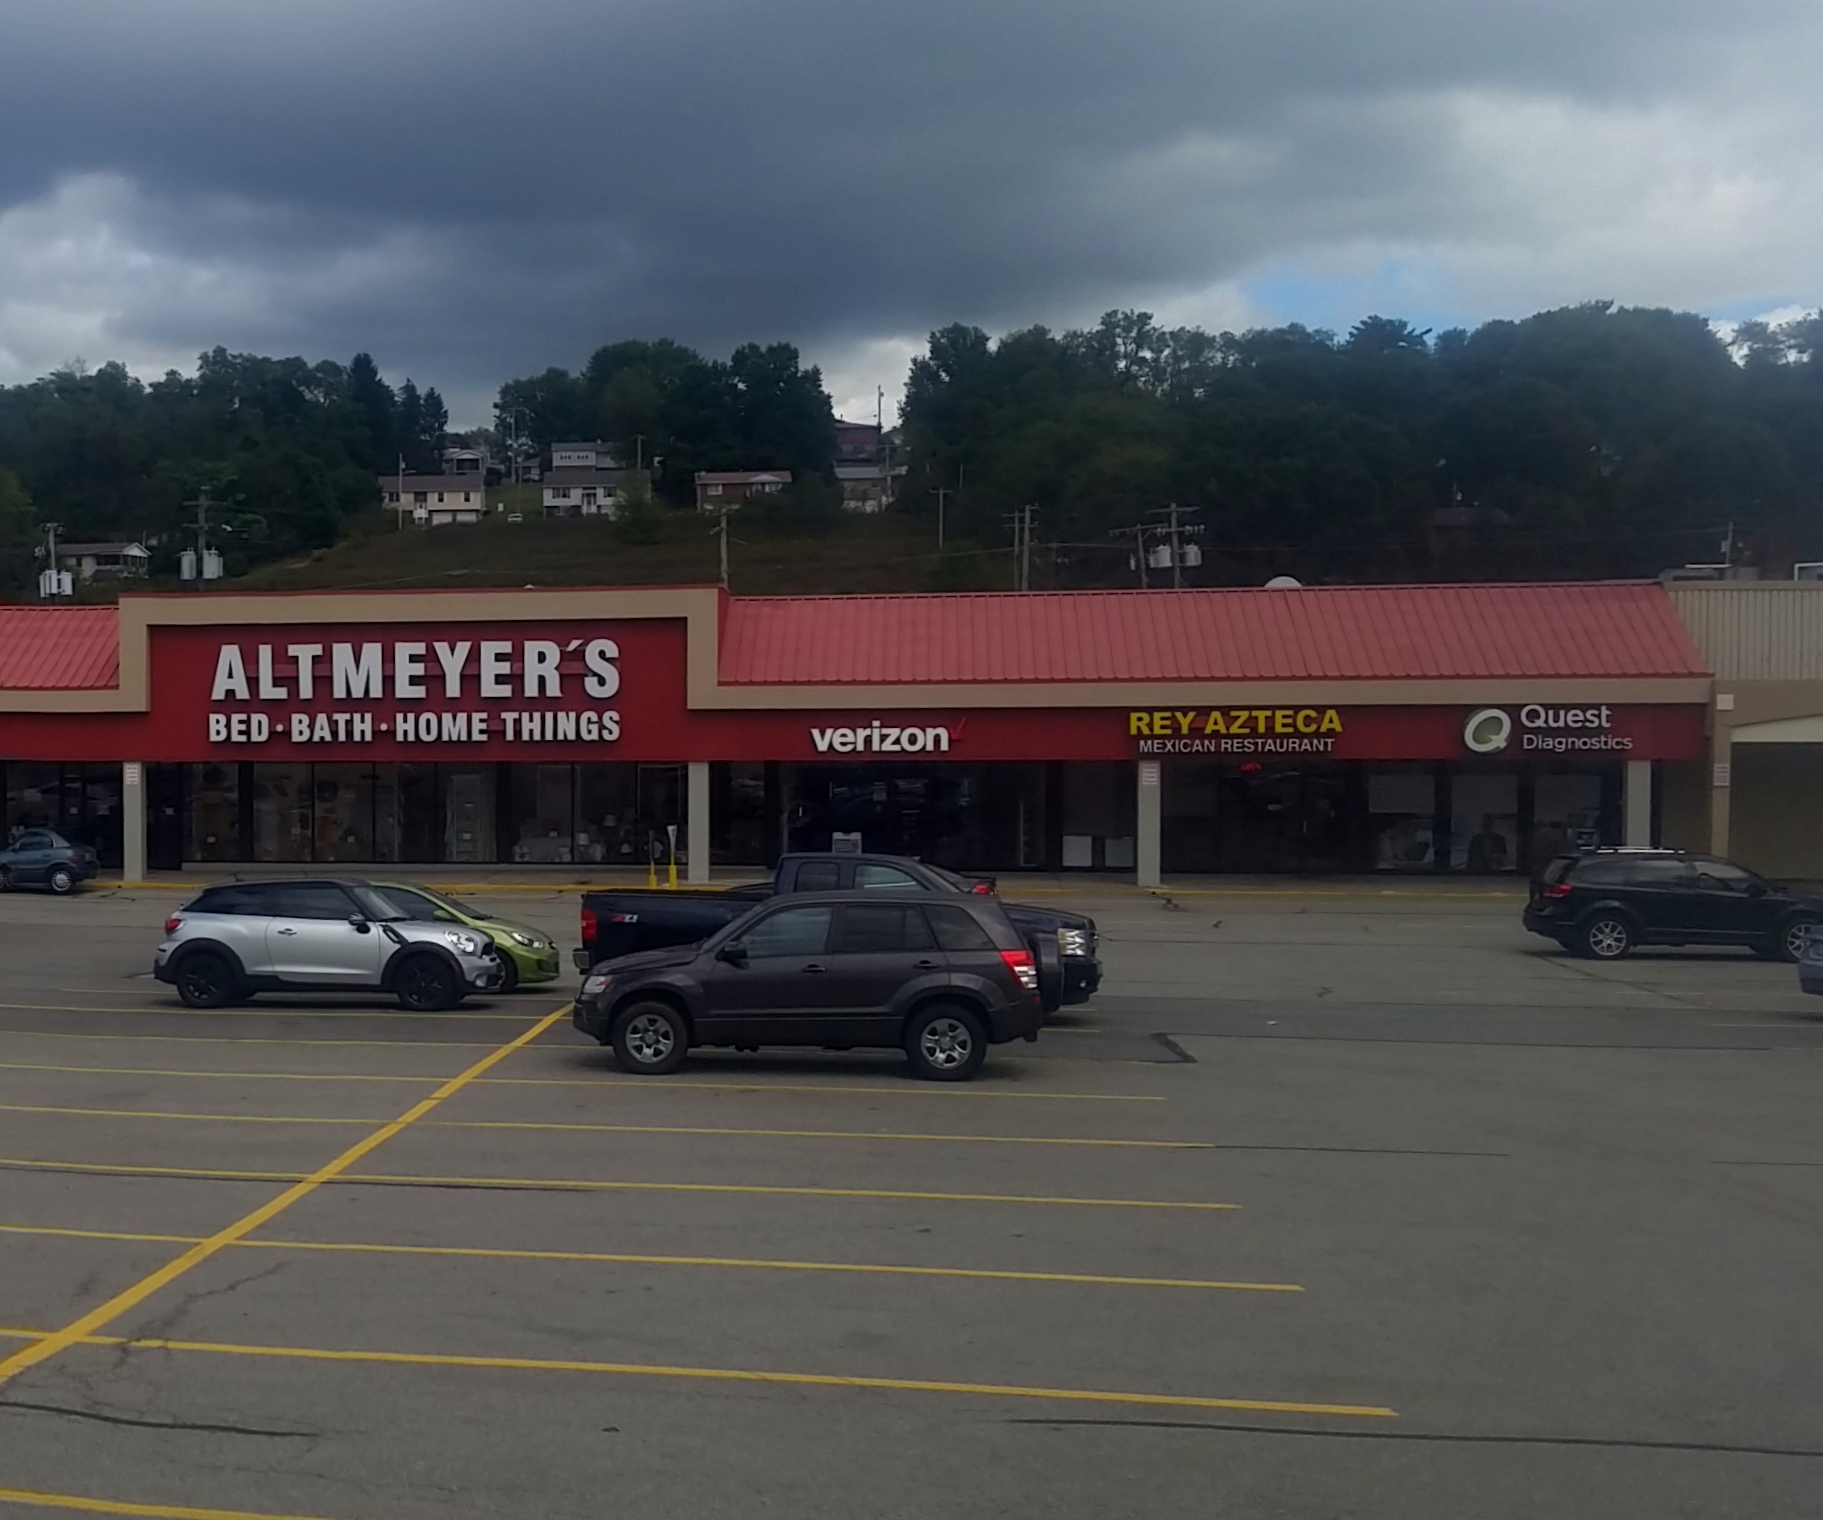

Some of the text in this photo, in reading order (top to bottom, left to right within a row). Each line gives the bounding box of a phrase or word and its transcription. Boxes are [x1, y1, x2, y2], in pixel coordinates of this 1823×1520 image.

[211, 638, 621, 701] ALTMEYER'S
[501, 710, 621, 742] THINGS
[1129, 709, 1344, 735] REY AZTECA
[1520, 704, 1612, 730] Quest
[811, 720, 950, 753] verizon
[1139, 737, 1336, 754] MEXICAN RESTAURANT
[1523, 734, 1633, 753] Diagnostics
